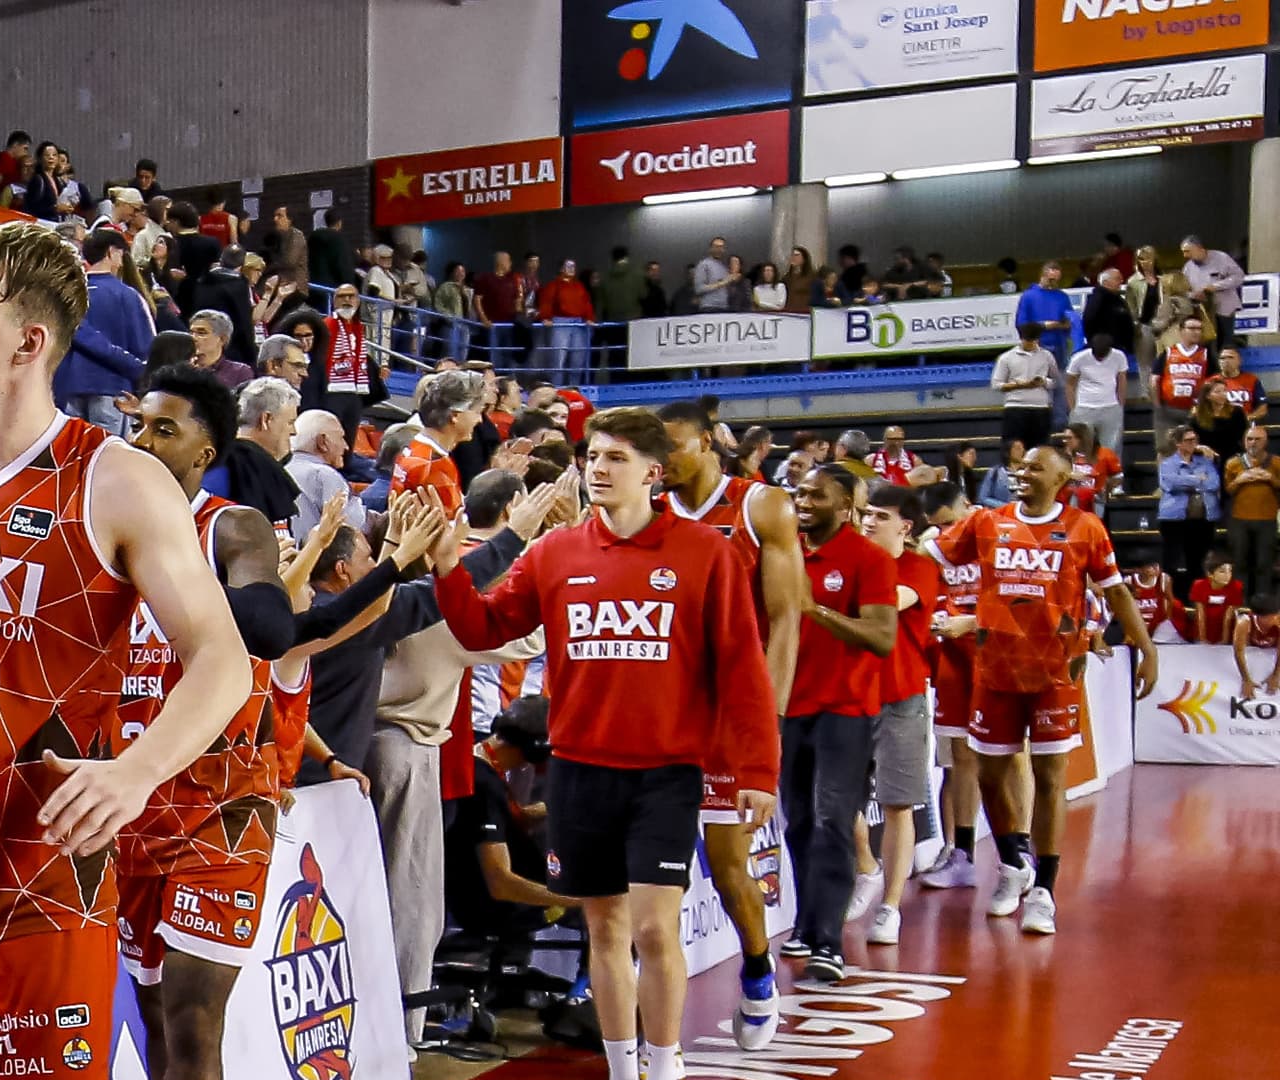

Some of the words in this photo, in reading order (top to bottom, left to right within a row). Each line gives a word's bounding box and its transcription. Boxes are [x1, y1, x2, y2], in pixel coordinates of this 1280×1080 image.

[903, 16, 939, 33] Sant
[943, 13, 989, 30] Josep
[1122, 24, 1146, 41] by
[1155, 12, 1241, 35] Logista
[1049, 78, 1095, 114] La
[1104, 64, 1232, 114] Tagliatella
[632, 139, 757, 176] Occident
[422, 158, 556, 196] ESTRELLA
[463, 188, 512, 206] DAMM
[911, 311, 1012, 333] BAGESNET
[943, 564, 982, 585] BAX
[995, 548, 1064, 573] BAXI
[567, 600, 675, 638] BAXI
[572, 642, 663, 658] MANRESA
[173, 890, 201, 914] ETL
[170, 909, 225, 938] GLOBAL
[272, 940, 351, 1025] BAXI
[60, 1014, 82, 1026] acb
[295, 1017, 346, 1065] MANRESA
[1068, 1016, 1185, 1073] Manresa
